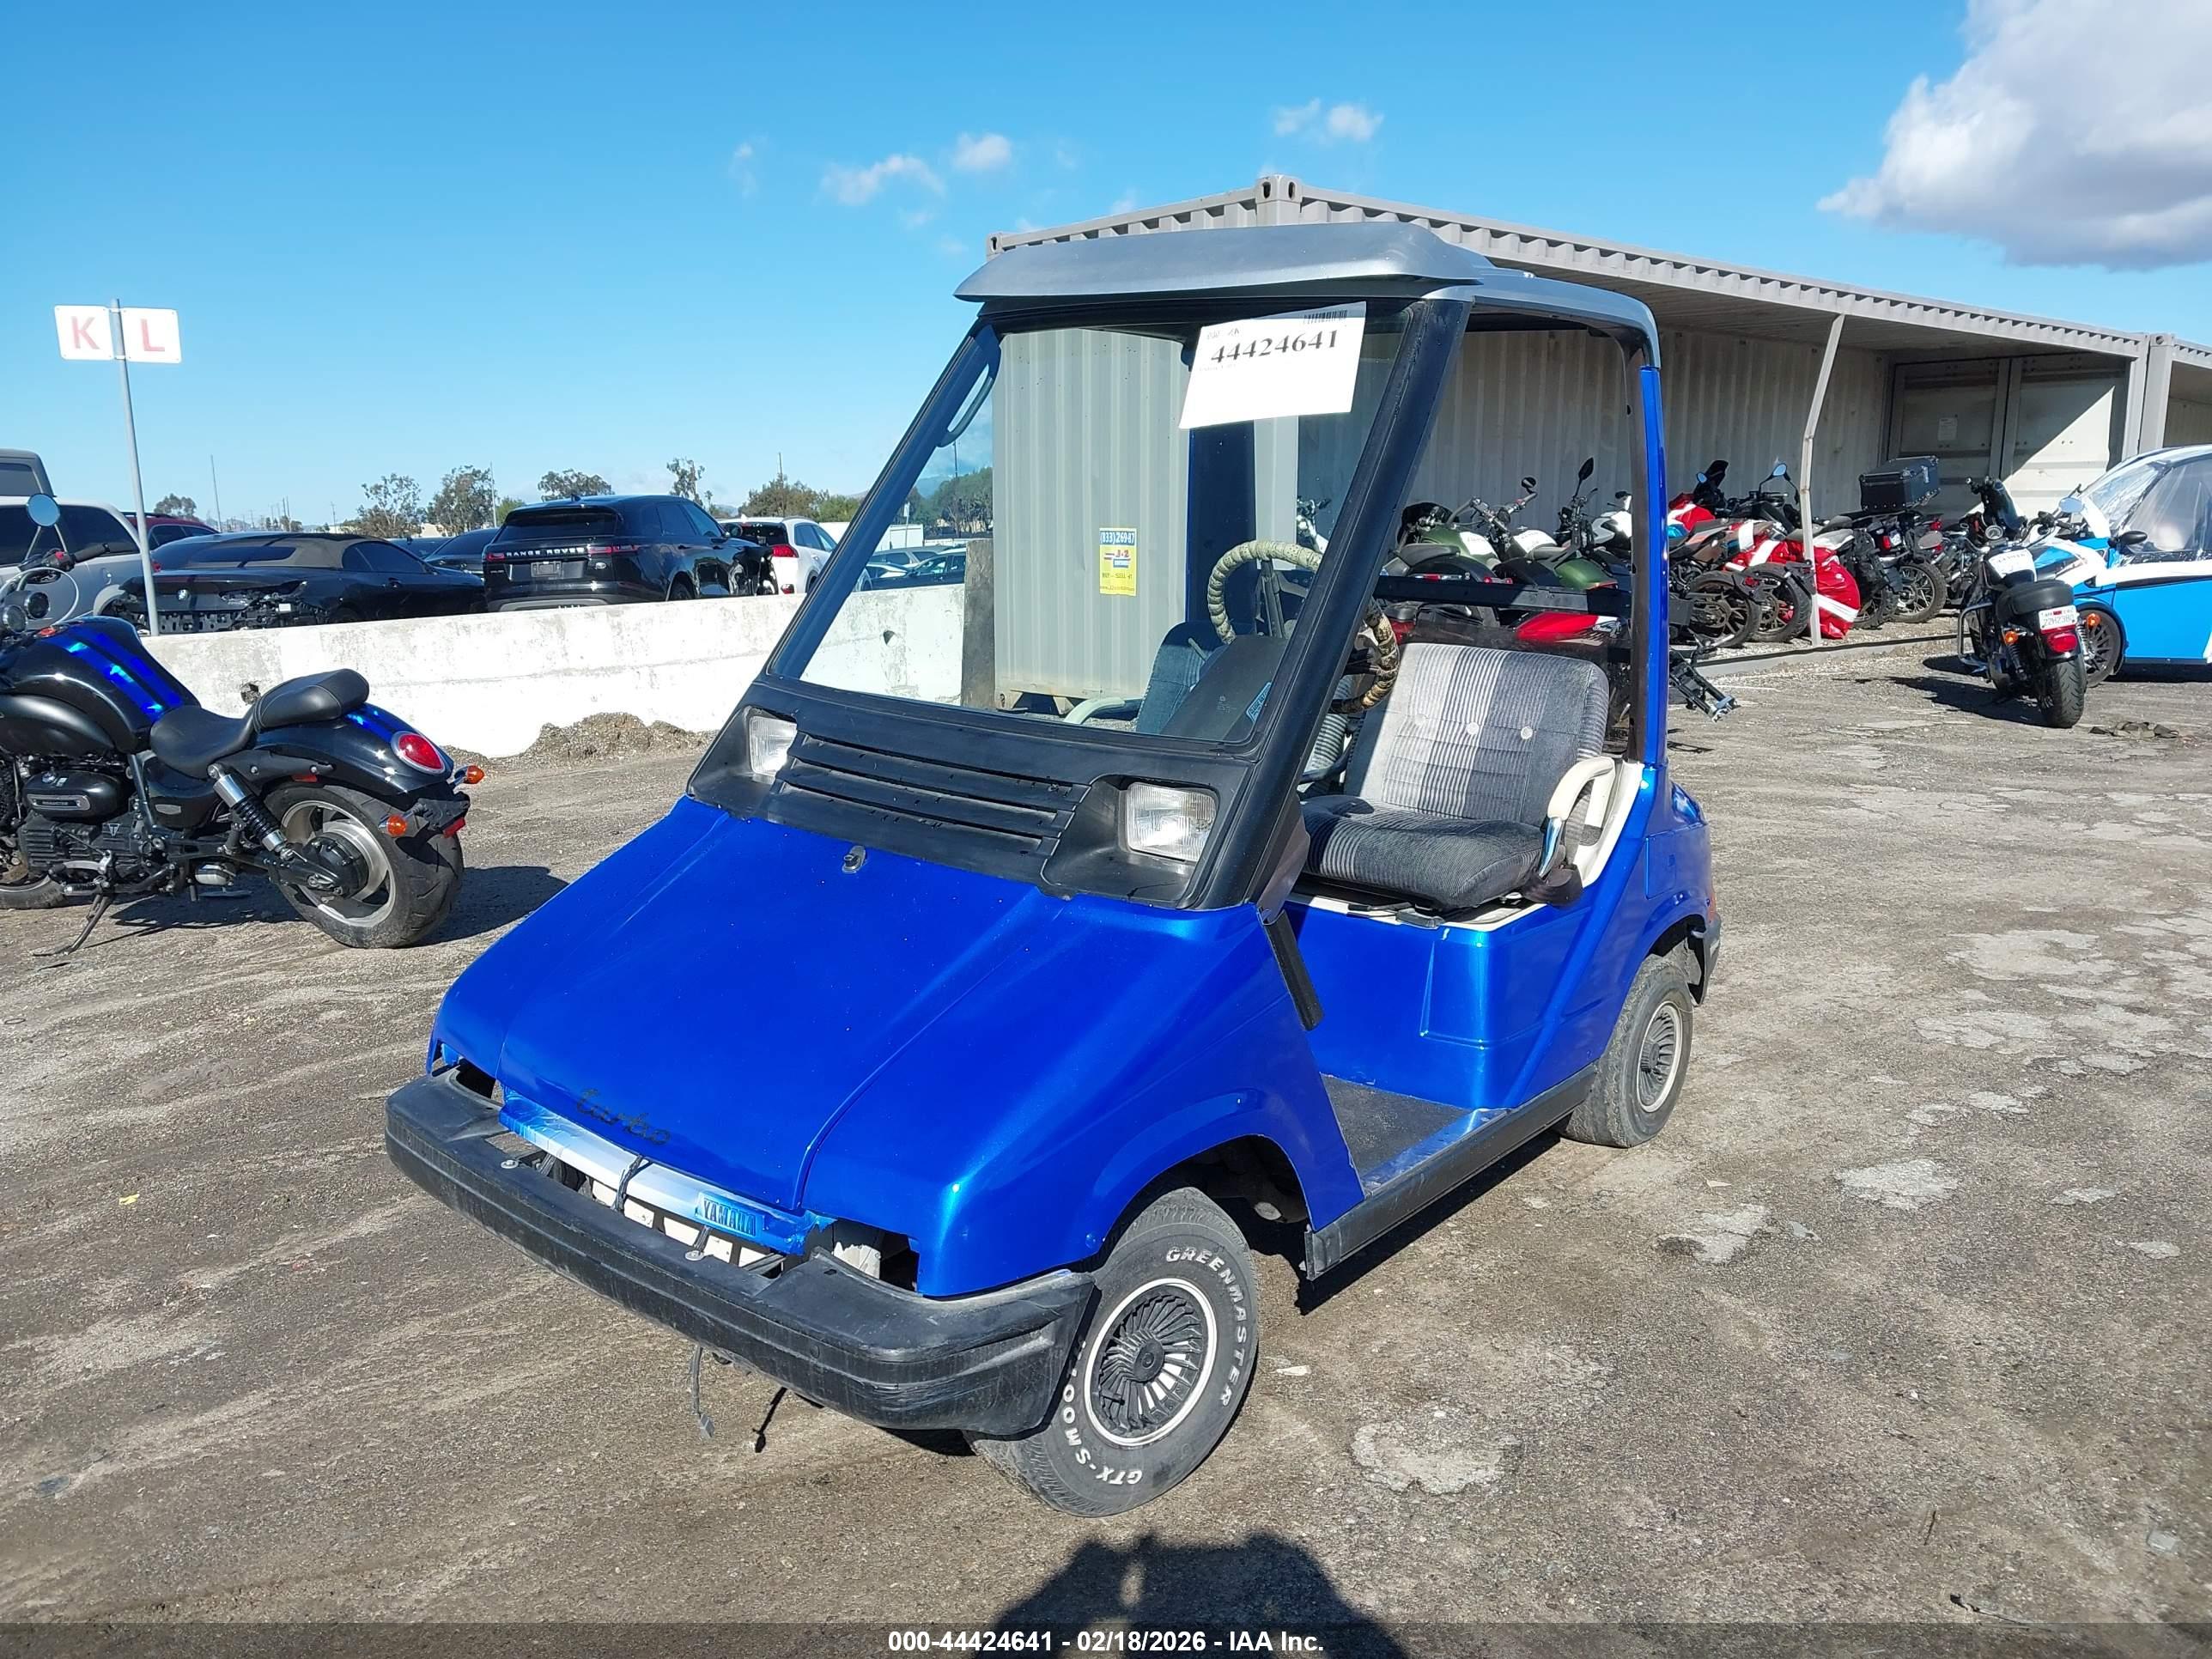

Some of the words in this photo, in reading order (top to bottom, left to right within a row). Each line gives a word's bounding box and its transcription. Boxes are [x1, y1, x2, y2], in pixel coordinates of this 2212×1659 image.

[71, 316, 100, 349] K
[140, 319, 166, 352] L
[1211, 330, 1337, 363] 44424641
[703, 1198, 756, 1237] YAMAHA
[1165, 1247, 1247, 1407] GREENMASTER
